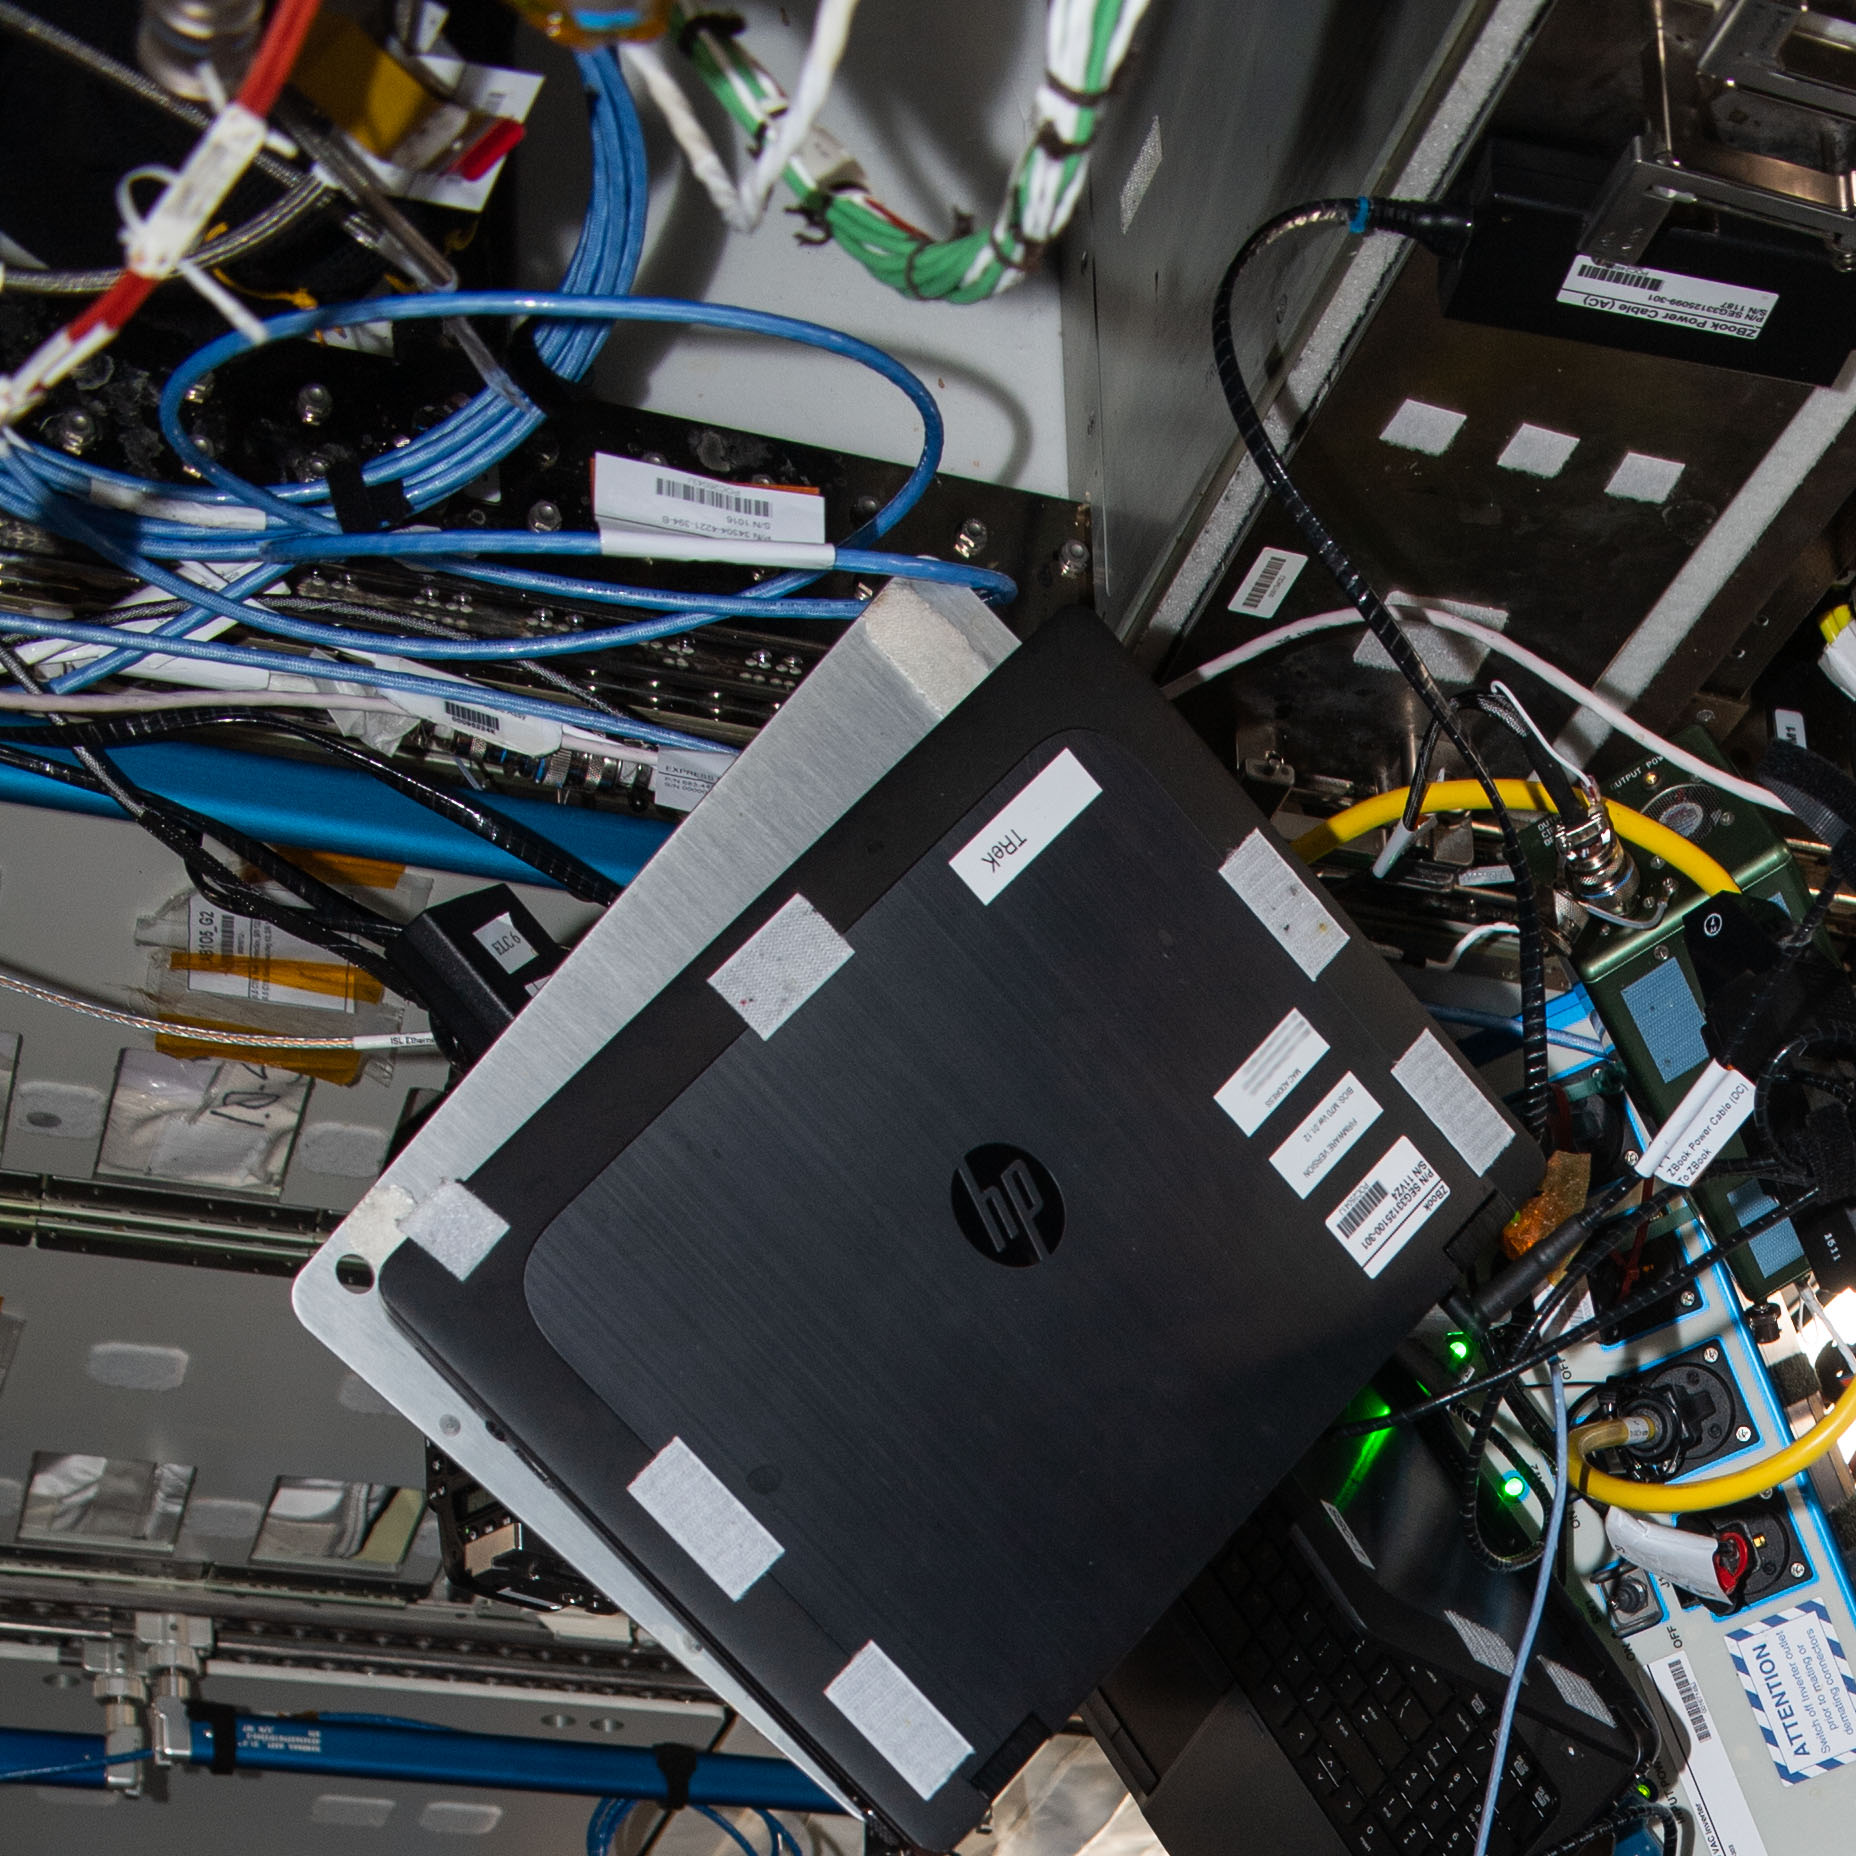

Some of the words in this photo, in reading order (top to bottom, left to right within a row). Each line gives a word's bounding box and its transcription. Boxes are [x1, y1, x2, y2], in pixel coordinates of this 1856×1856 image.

[1582, 294, 1615, 310] (AC)
[1618, 301, 1658, 319] Cable
[1720, 300, 1745, 311] 1187
[1747, 305, 1766, 316] S/N
[1662, 310, 1706, 327] Power
[1711, 320, 1756, 338] ZBook
[978, 825, 1027, 873] TReK
[491, 934, 516, 957] ELC
[508, 930, 522, 945] 6
[1666, 1148, 1691, 1178] ZBook
[1688, 1123, 1712, 1152] Power
[1708, 1100, 1731, 1126] Cable
[1727, 1081, 1748, 1104] (DC)
[1677, 1171, 1690, 1186] To
[1686, 1146, 1711, 1176] ZBook
[1420, 1182, 1449, 1212] ZBook
[1774, 1630, 1793, 1660] outlet
[1796, 1643, 1806, 1655] or
[1804, 1628, 1833, 1685] connectors
[1787, 1661, 1810, 1701] Inverter
[1800, 1656, 1823, 1693] mating
[1752, 1644, 1810, 1758] ATTENTION
[1801, 1701, 1816, 1717] off
[1815, 1694, 1826, 1706] to
[1827, 1688, 1855, 1735] demating
[1819, 1707, 1838, 1731] prior
[1808, 1717, 1831, 1754] Switch
[1693, 1802, 1713, 1835] Inverter
[1706, 1835, 1720, 1854] VAC
